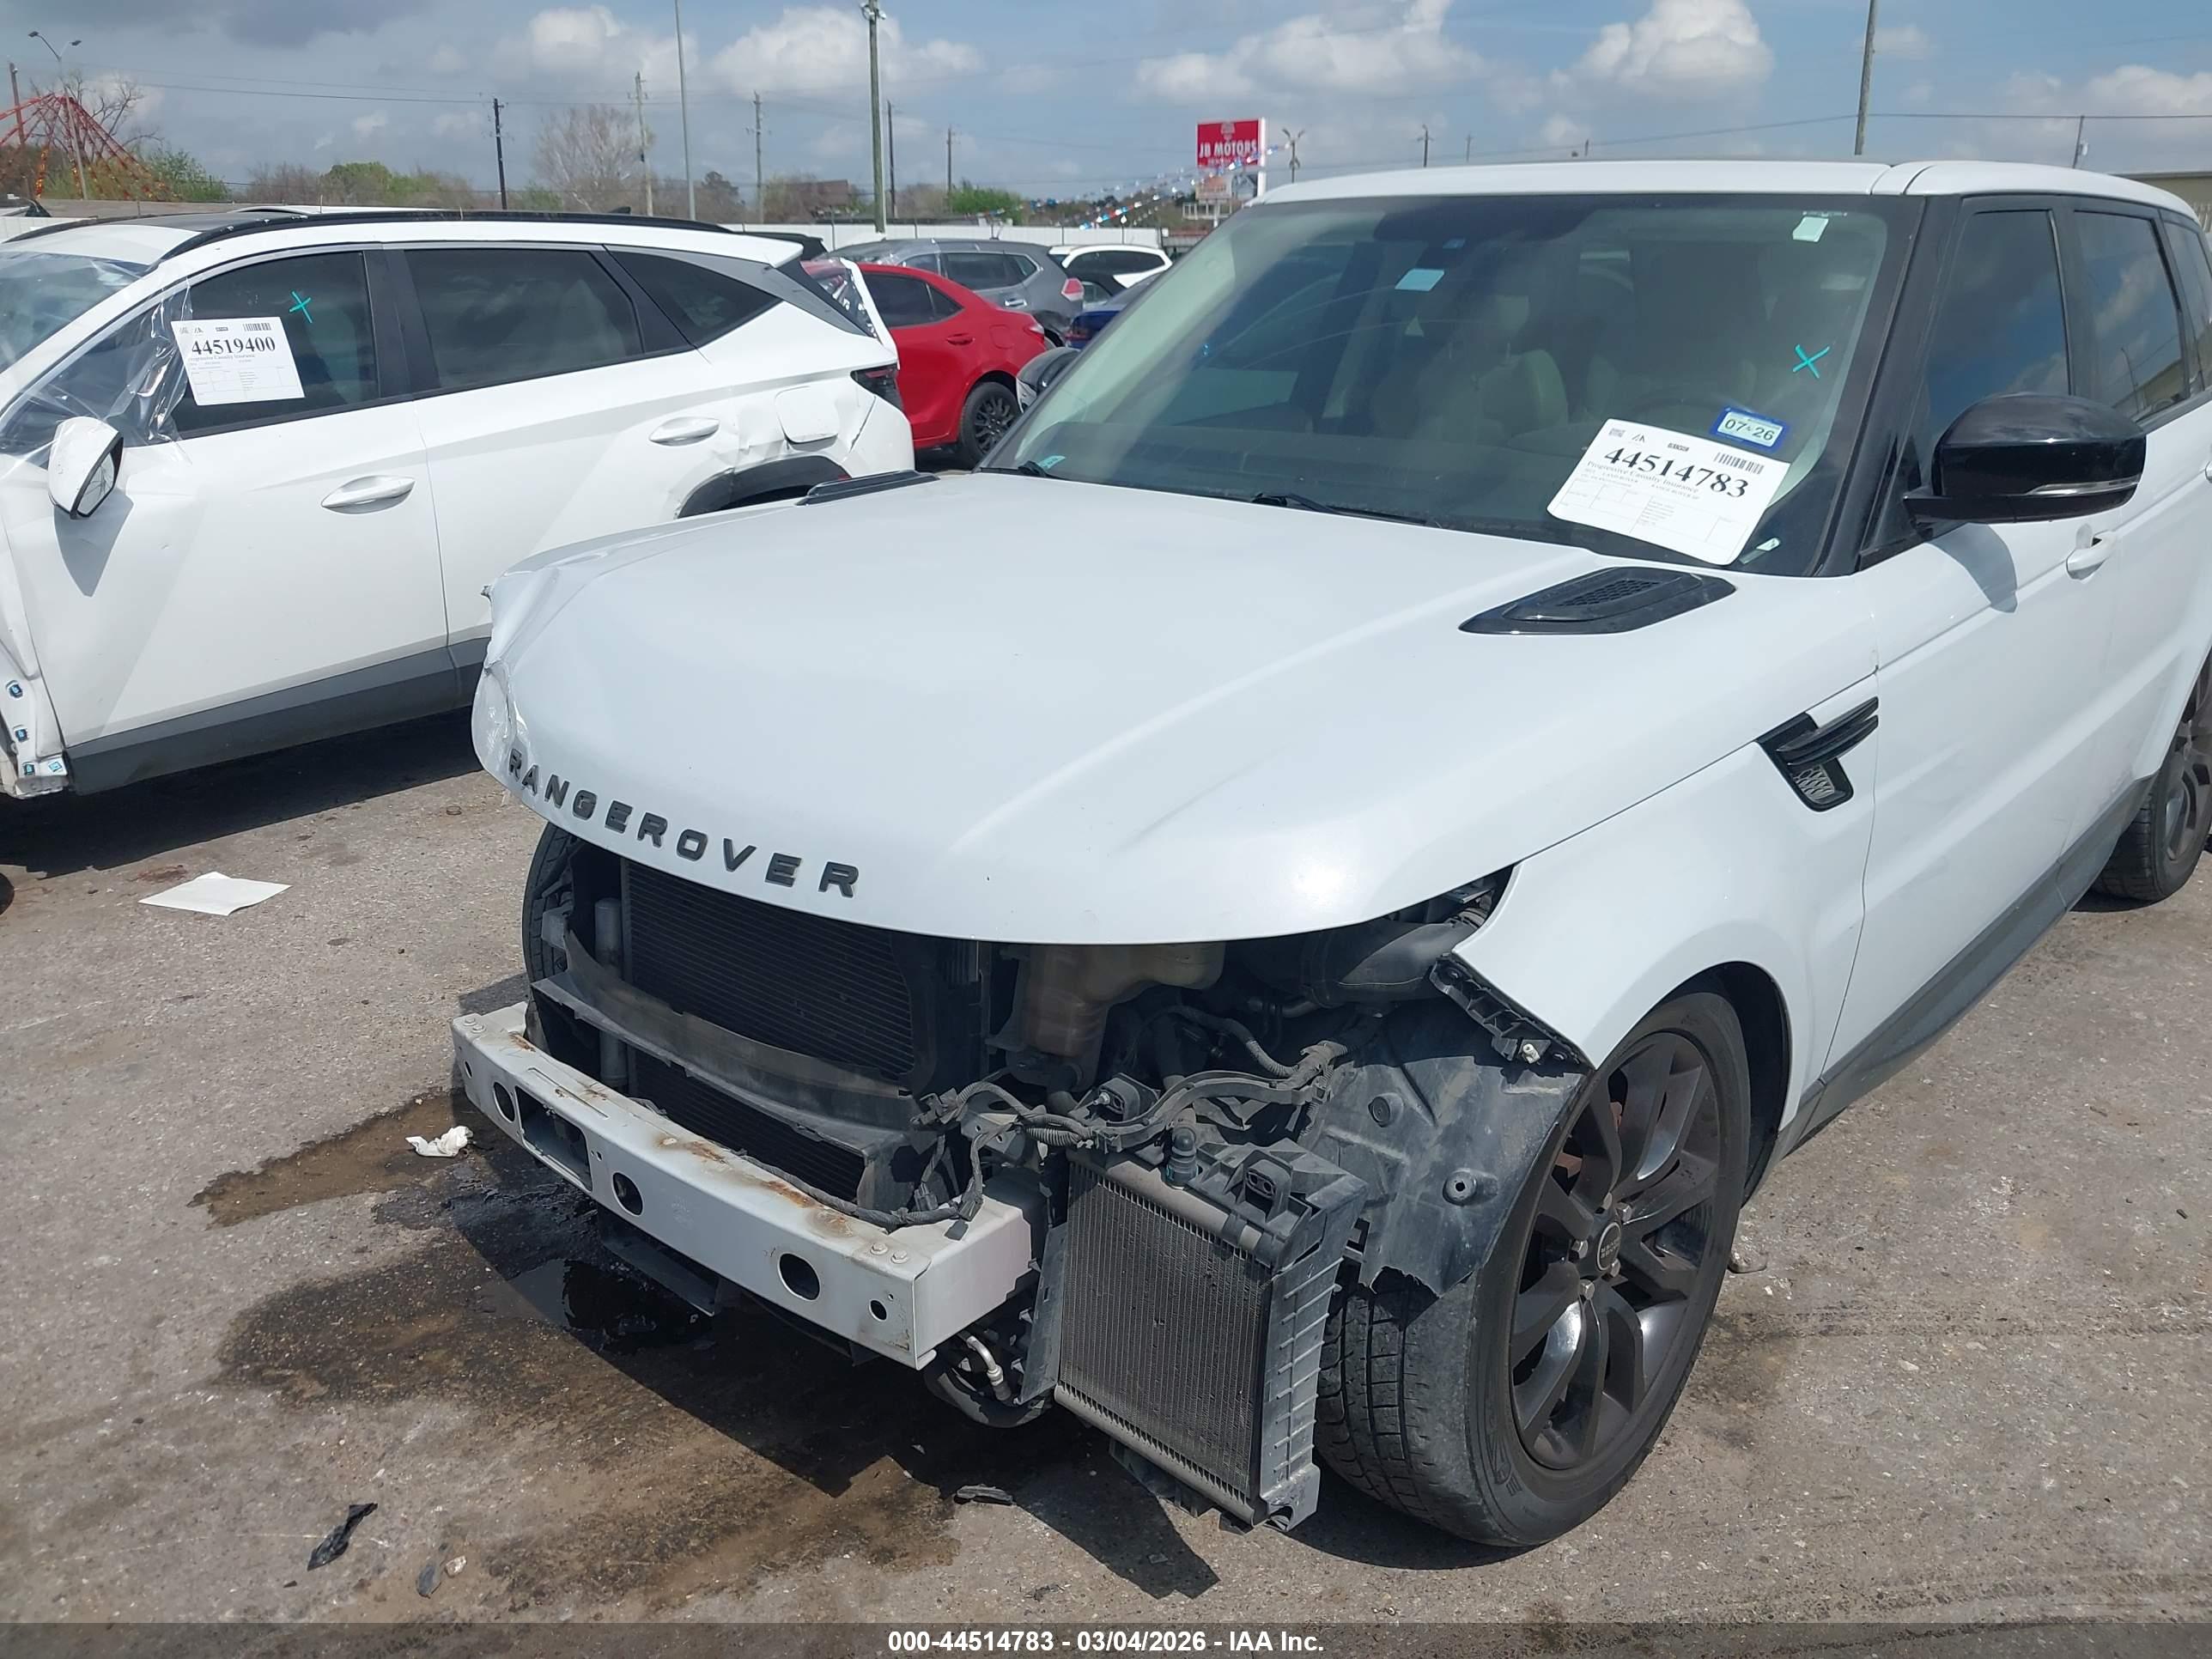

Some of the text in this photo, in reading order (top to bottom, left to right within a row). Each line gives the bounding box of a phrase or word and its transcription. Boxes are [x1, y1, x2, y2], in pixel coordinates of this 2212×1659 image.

[1213, 139, 1257, 157] MOTORS
[191, 336, 276, 355] 44519400
[1752, 427, 1775, 441] 26
[1604, 447, 1748, 498] 44514783
[1663, 479, 1699, 493] Insurance
